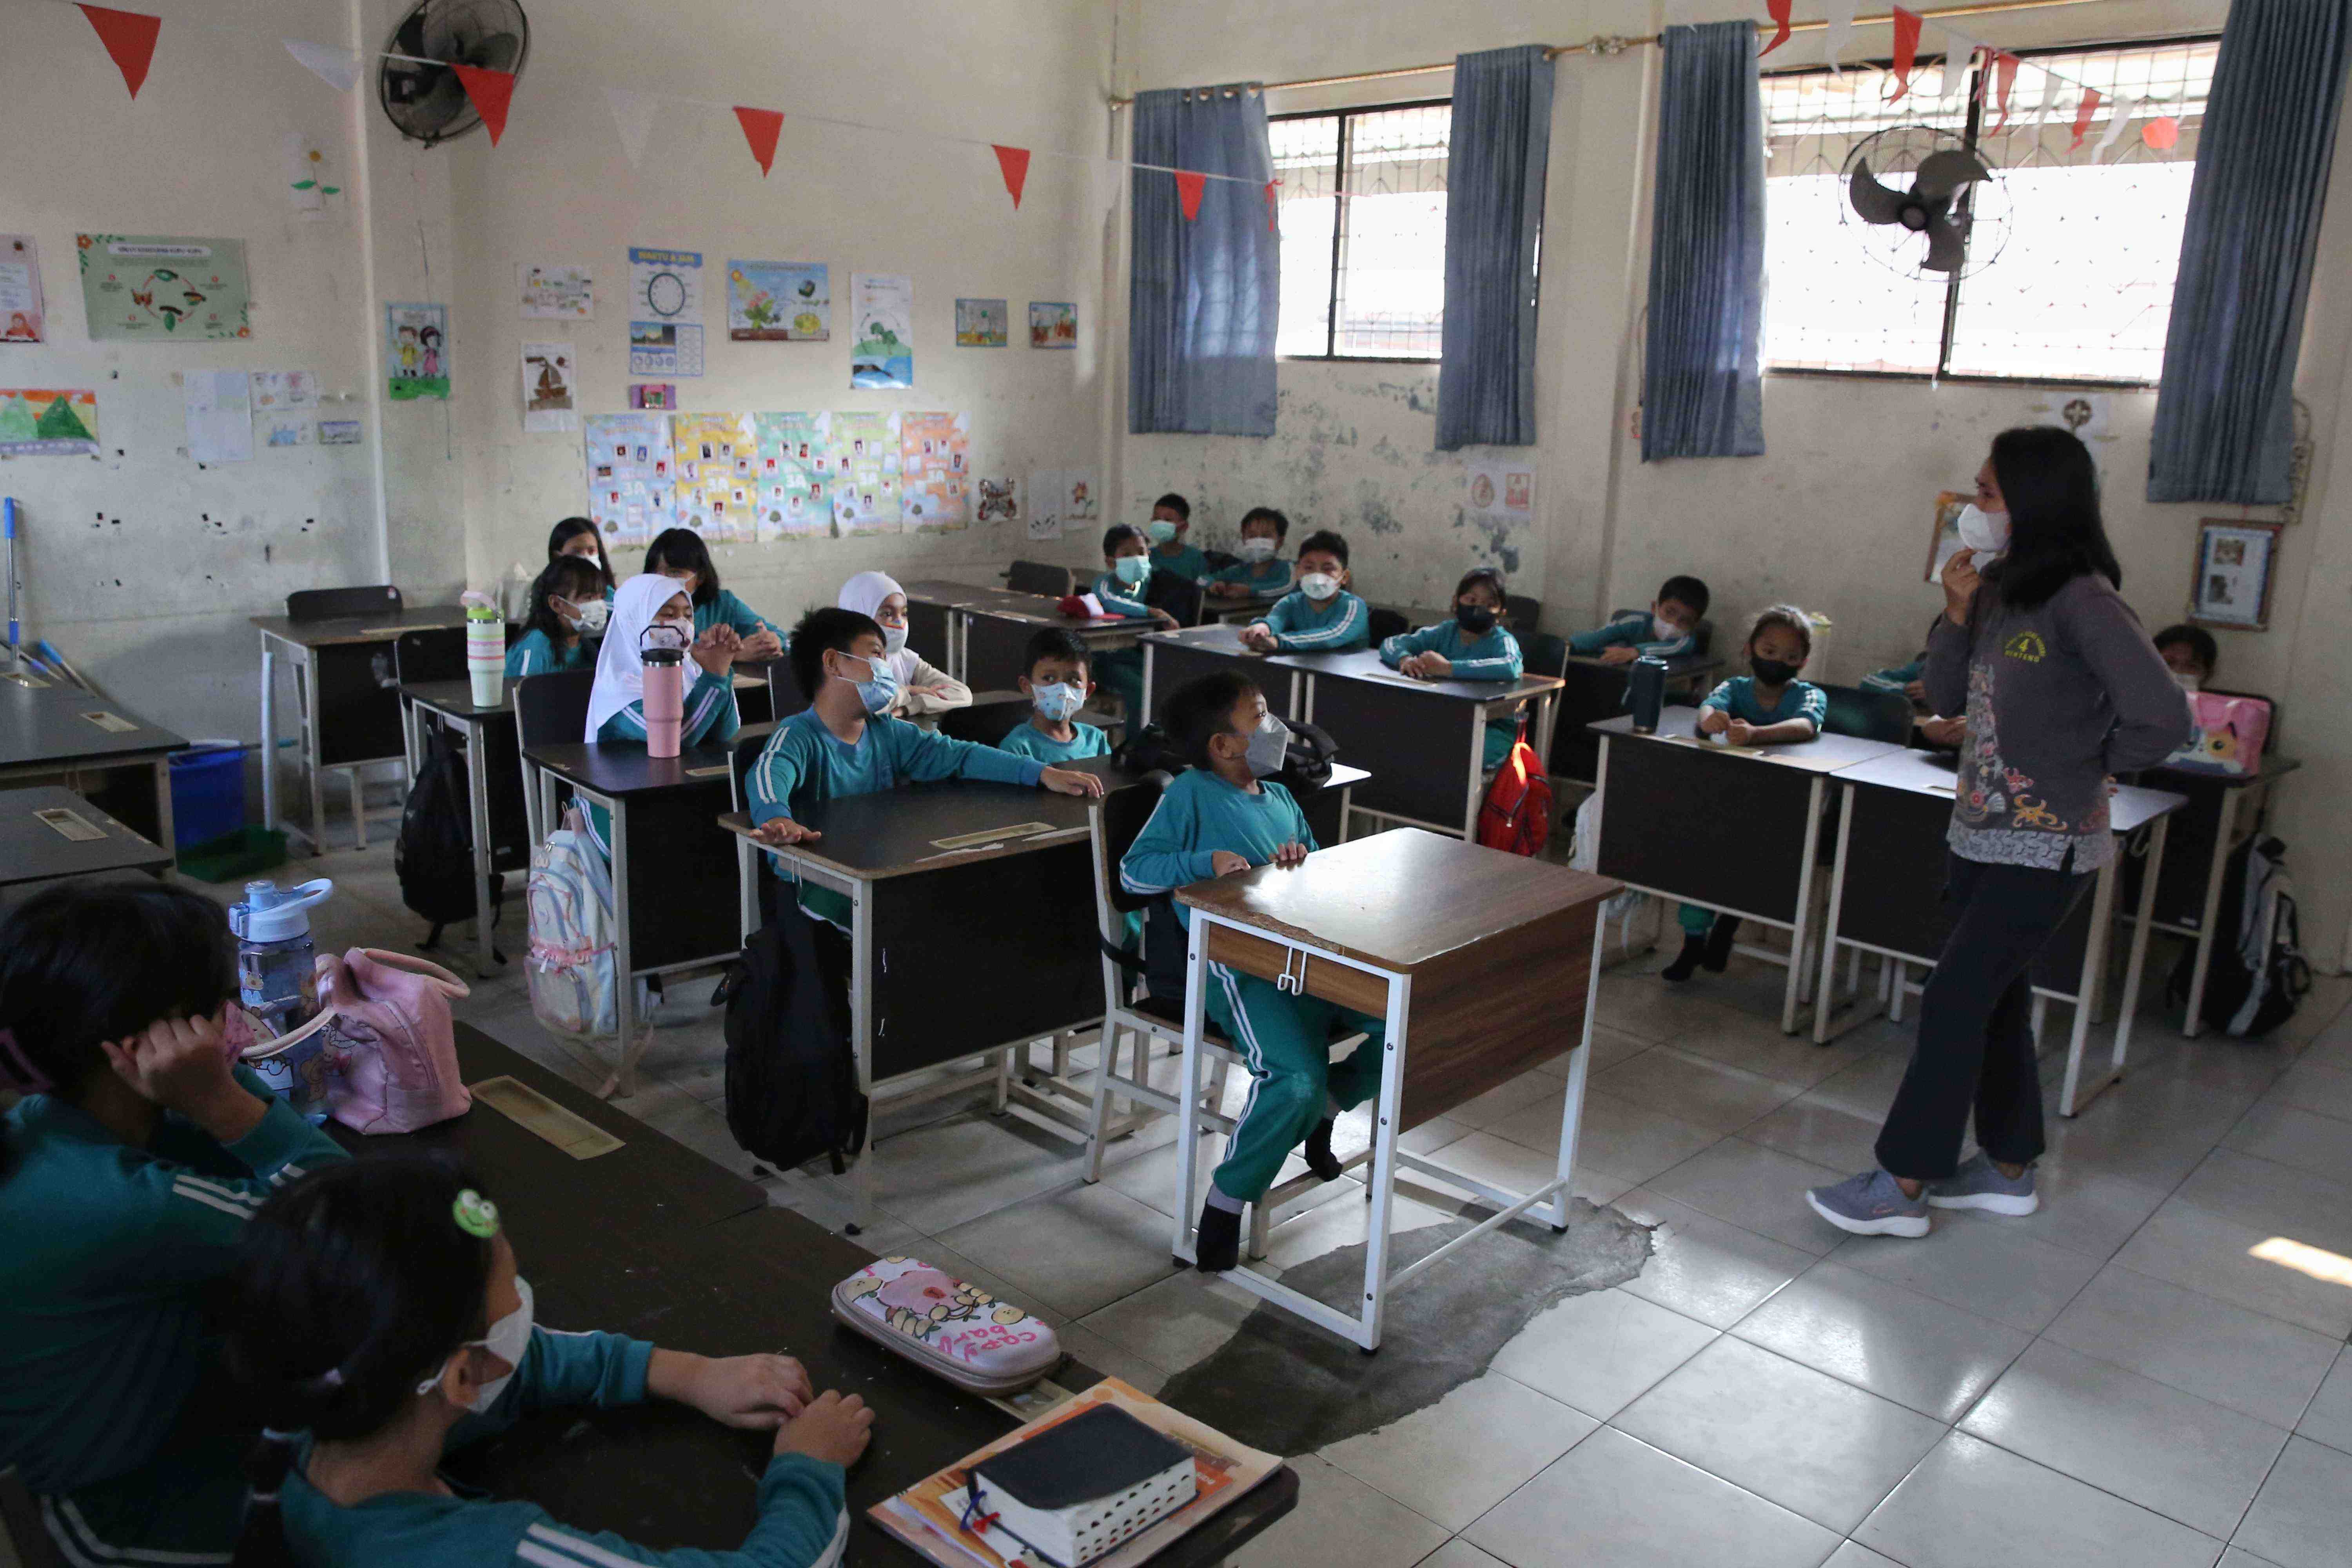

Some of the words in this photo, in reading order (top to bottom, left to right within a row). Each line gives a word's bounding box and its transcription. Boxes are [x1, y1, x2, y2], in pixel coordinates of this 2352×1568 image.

[707, 478, 730, 492] 3A
[786, 473, 807, 488] 3A
[622, 481, 646, 496] 3A
[2018, 639, 2029, 653] 4
